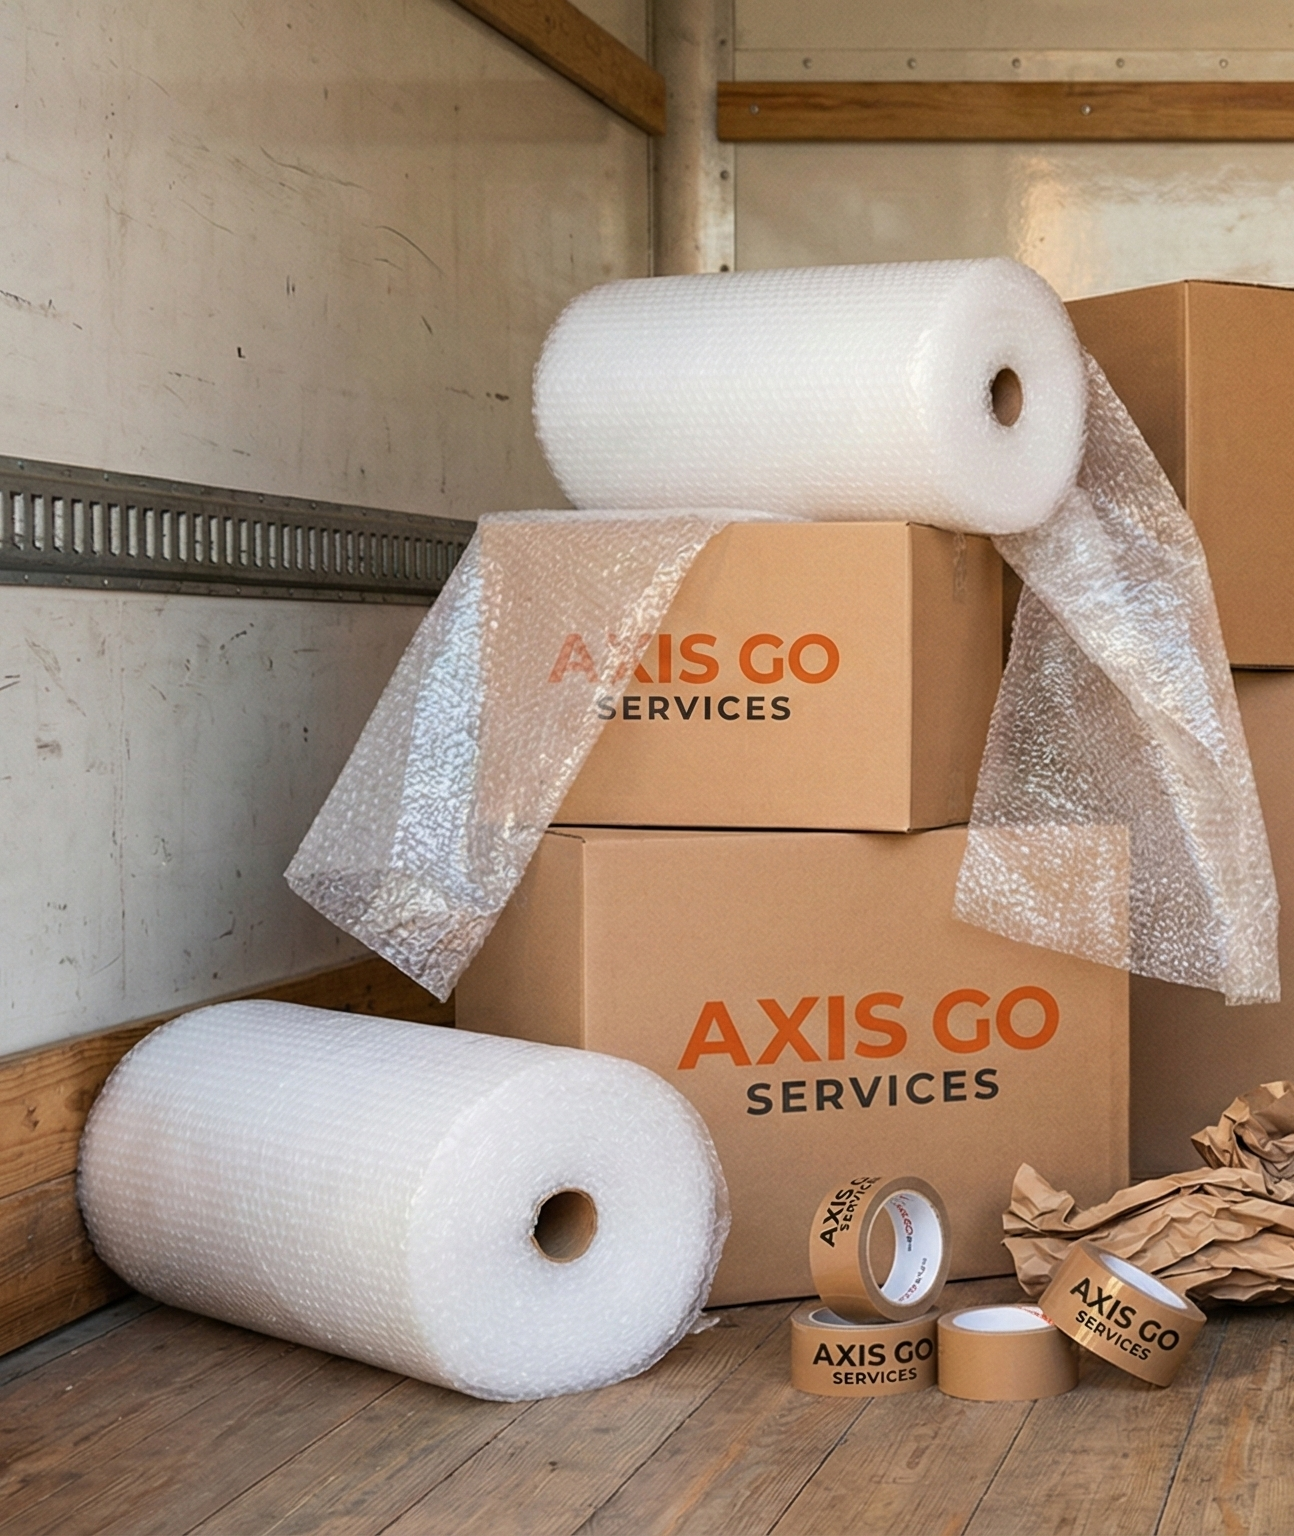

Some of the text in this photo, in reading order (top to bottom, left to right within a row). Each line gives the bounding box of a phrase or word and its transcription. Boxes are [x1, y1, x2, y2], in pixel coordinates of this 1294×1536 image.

[547, 633, 840, 685] AXIS GO
[597, 695, 792, 721] SERVICES
[677, 985, 1060, 1070] AXIS GO
[746, 1068, 1000, 1116] SERVICES
[820, 1189, 854, 1248] AXIS
[1069, 1277, 1137, 1330] AXIS
[1138, 1319, 1180, 1351] GO
[1075, 1310, 1152, 1361] SERVICES
[812, 1338, 934, 1367] AXIS GO
[832, 1367, 917, 1385] SERVICES
